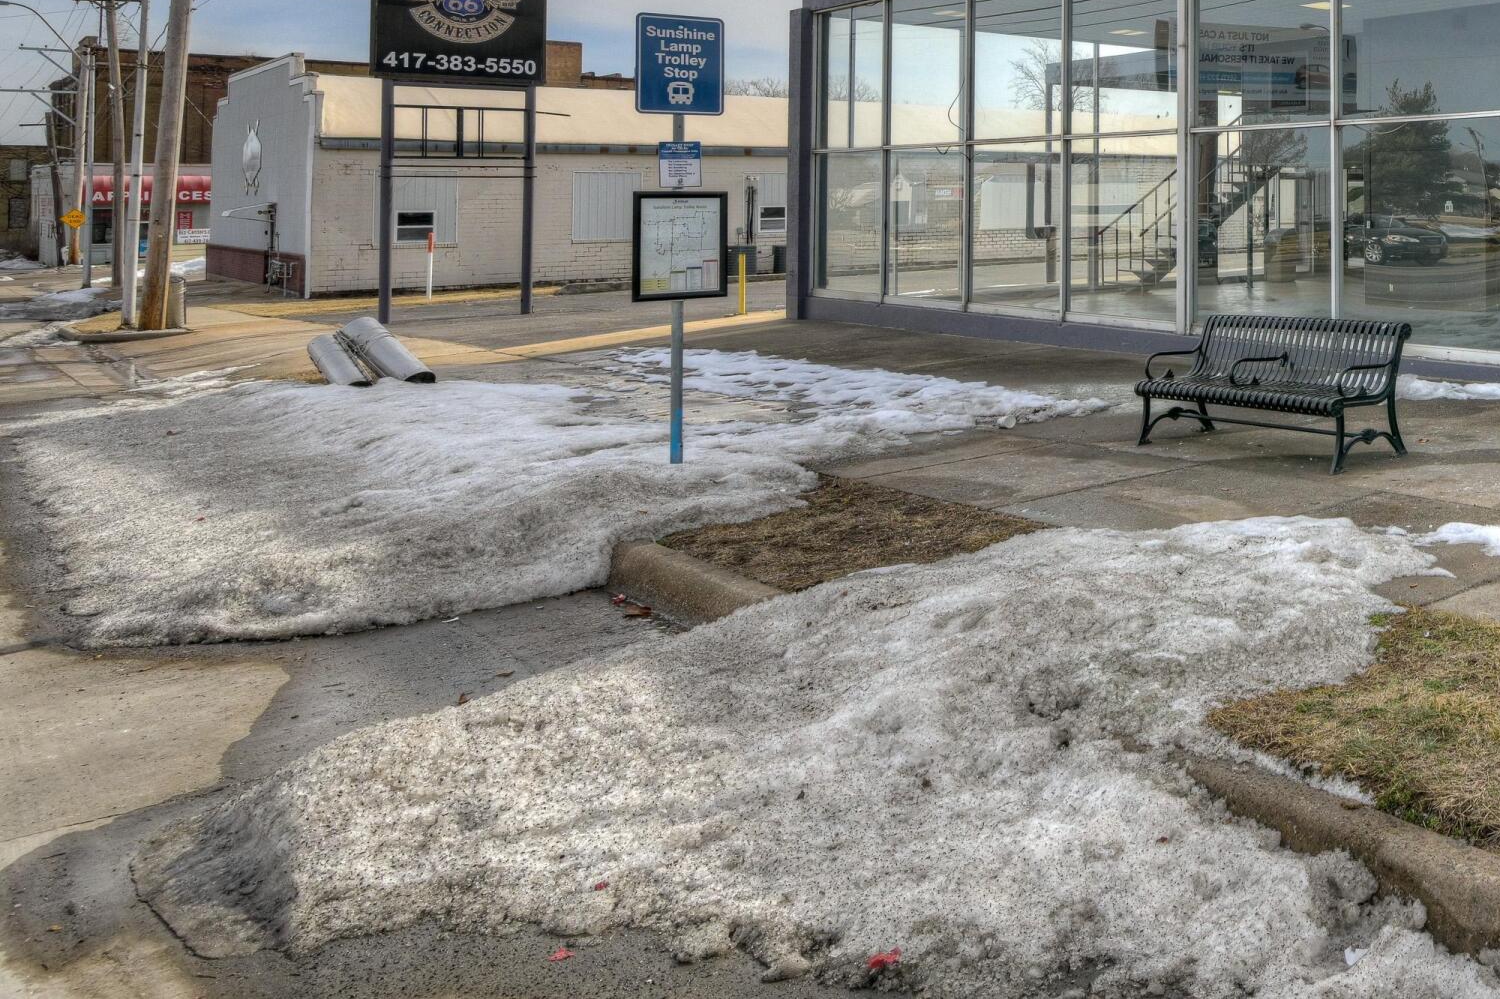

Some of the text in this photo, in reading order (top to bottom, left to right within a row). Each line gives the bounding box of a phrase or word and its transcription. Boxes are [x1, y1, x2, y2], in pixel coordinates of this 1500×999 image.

[418, 10, 508, 39] CONNECTION
[646, 25, 715, 41] Sunshine
[660, 40, 702, 56] Lamp
[383, 51, 537, 76] 417-383-5550
[655, 53, 707, 69] Trolley
[664, 67, 698, 80] Stop
